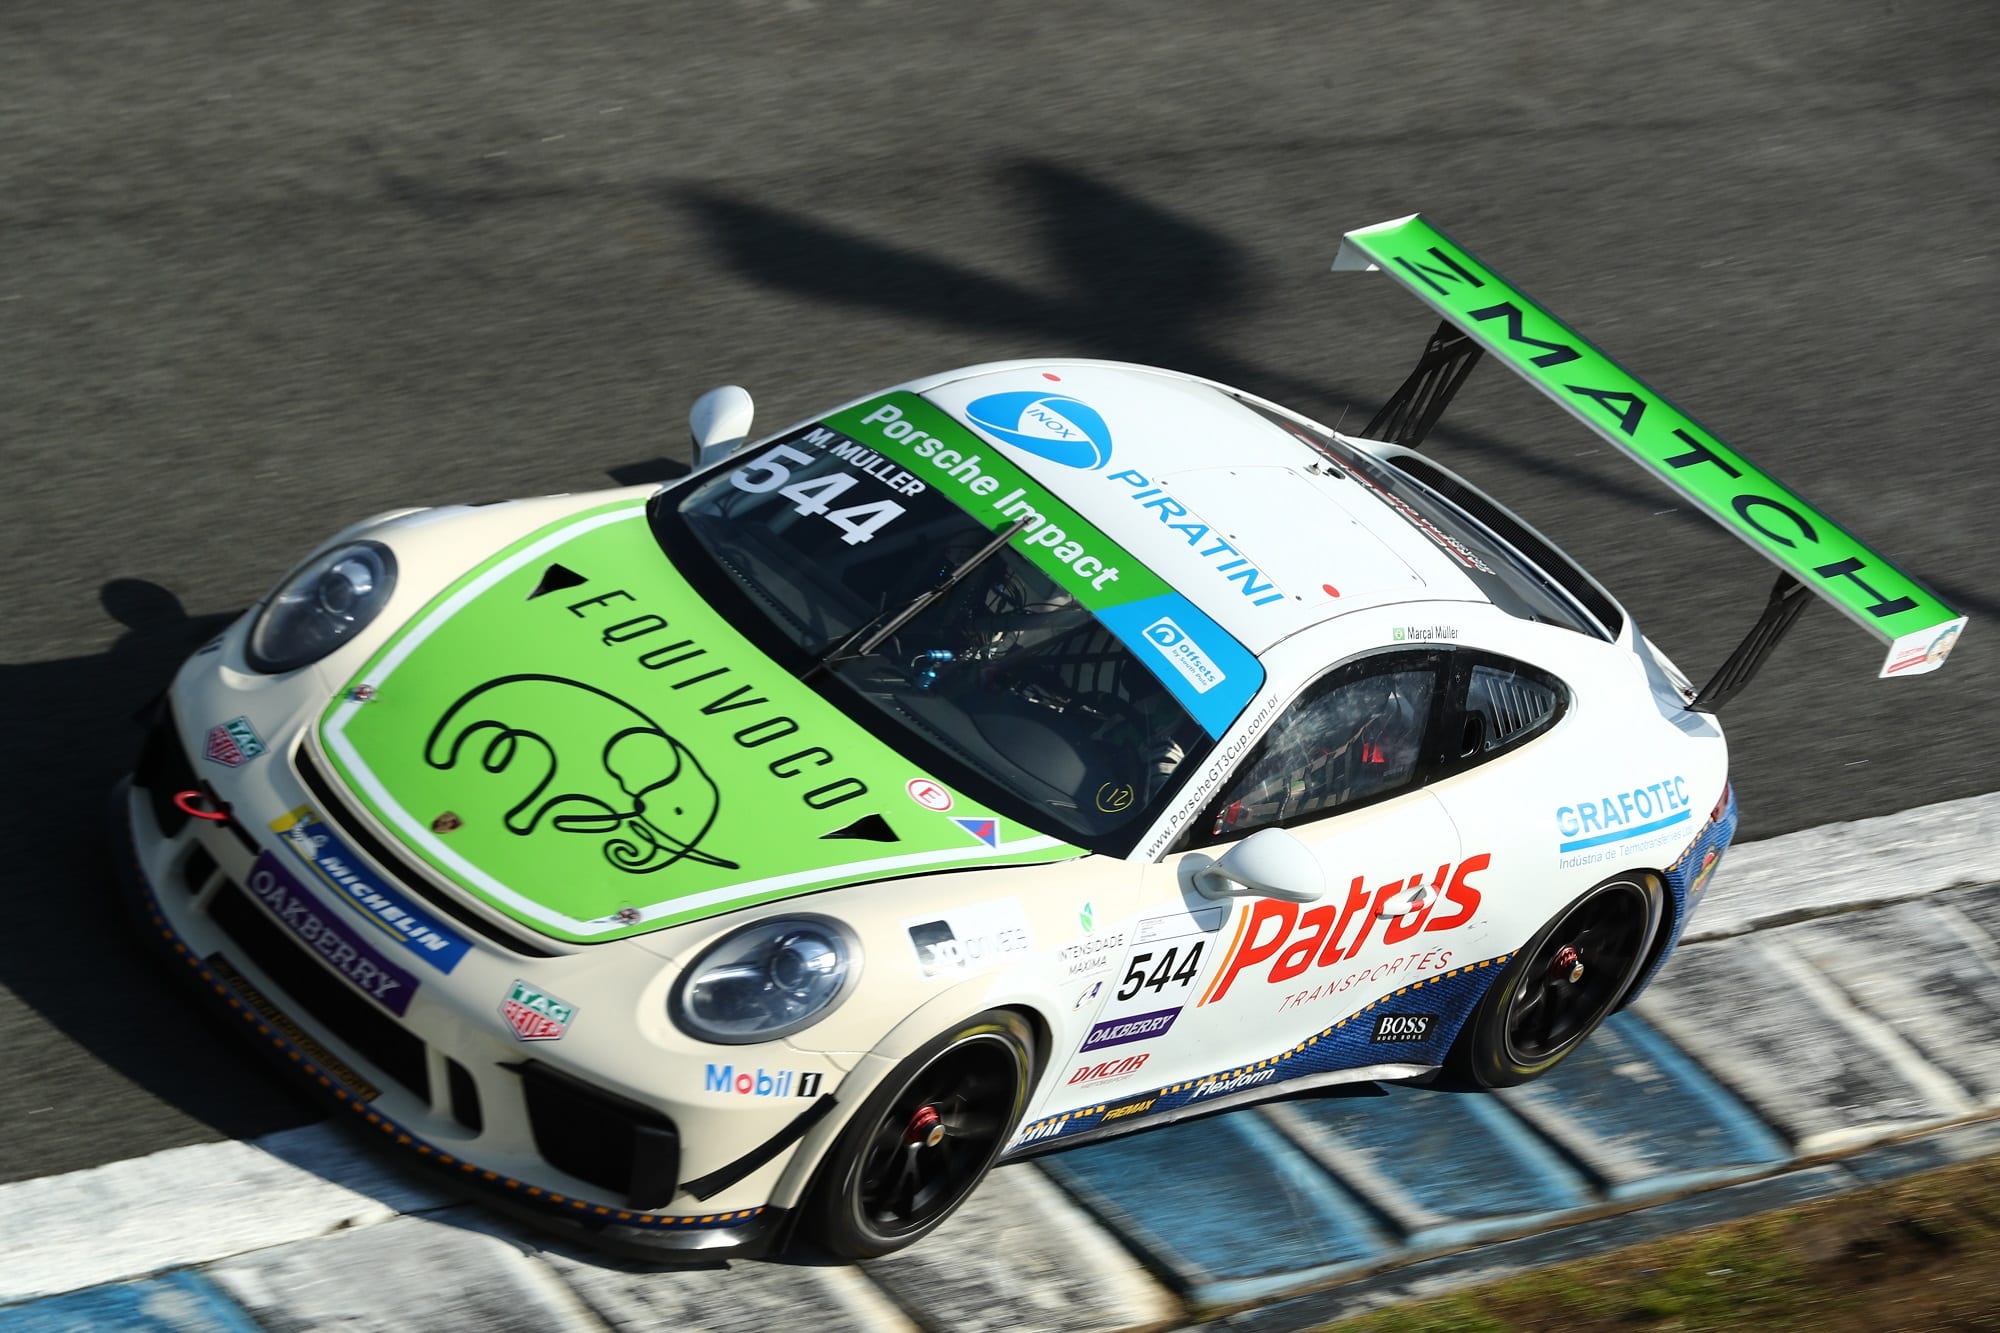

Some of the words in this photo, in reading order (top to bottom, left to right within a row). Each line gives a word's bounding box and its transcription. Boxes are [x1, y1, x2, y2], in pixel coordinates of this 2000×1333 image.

[1027, 409, 1076, 438] INOX
[1393, 247, 1919, 617] ZMATCH
[802, 428, 829, 448] M.
[829, 446, 927, 497] MÜLLER
[730, 444, 906, 546] 544
[860, 404, 999, 496] Porsche
[992, 488, 1119, 591] Impact
[1107, 469, 1285, 606] PIRATINI
[1407, 625, 1433, 640] Marçal
[1179, 644, 1216, 682] offsets
[567, 590, 868, 810] EQUIVOCO
[228, 719, 262, 758] TAG
[918, 786, 942, 804] E
[1146, 693, 1279, 858] www.PorscheGT3Cup.com.br
[1556, 776, 1689, 837] GRAFOTEC
[1605, 849, 1616, 860] de
[319, 857, 450, 951] MICHELIN
[252, 871, 400, 998] OAKBERRY
[1059, 934, 1123, 961] INTENSIDADE
[1209, 853, 1491, 1004] Patrus
[1117, 941, 1205, 1001] 544
[1279, 951, 1453, 1013] TRANSPORTES
[513, 983, 571, 1023] TAG
[1088, 1015, 1175, 1045] OAKBERRY
[1379, 1017, 1429, 1034] BOSS
[705, 1064, 793, 1097] Mobil
[1067, 1053, 1150, 1085] DACAR
[1193, 1068, 1275, 1097] Flexform
[1101, 1098, 1157, 1122] FREMAX
